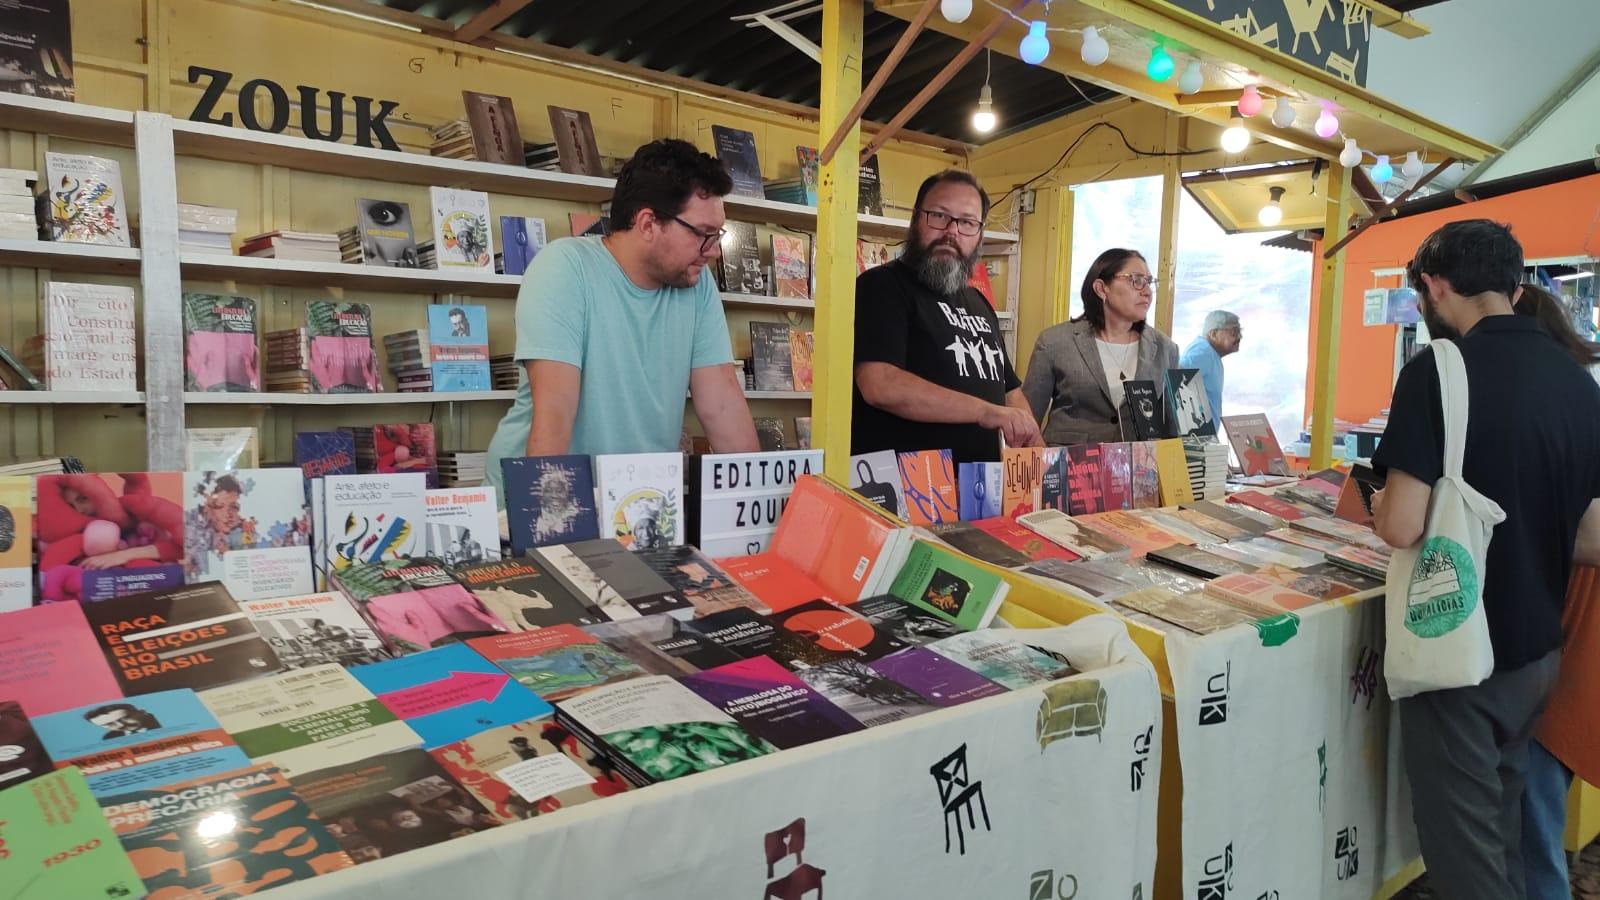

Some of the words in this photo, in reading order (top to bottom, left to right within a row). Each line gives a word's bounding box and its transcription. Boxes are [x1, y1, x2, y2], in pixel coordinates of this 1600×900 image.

[188, 66, 402, 152] ZOUK
[937, 301, 993, 337] BEATLES
[713, 457, 812, 490] EDITORA
[1007, 448, 1041, 495] SEGUNDO
[453, 492, 487, 505] Benjamin
[100, 613, 168, 636] RAÇA
[107, 634, 123, 647] E
[112, 623, 229, 657] ELEIÇÕES
[118, 652, 159, 669] NO
[124, 652, 216, 681] BRASIL
[734, 689, 780, 705] NEBULOSA
[778, 685, 793, 693] DO
[288, 708, 371, 733] LIBERALISMO
[311, 721, 373, 742] FASCISMO
[348, 715, 366, 725] DO
[102, 770, 274, 818] DEMOCRACIA
[108, 791, 243, 830] PRECÁRIA
[42, 837, 103, 869] 1930
